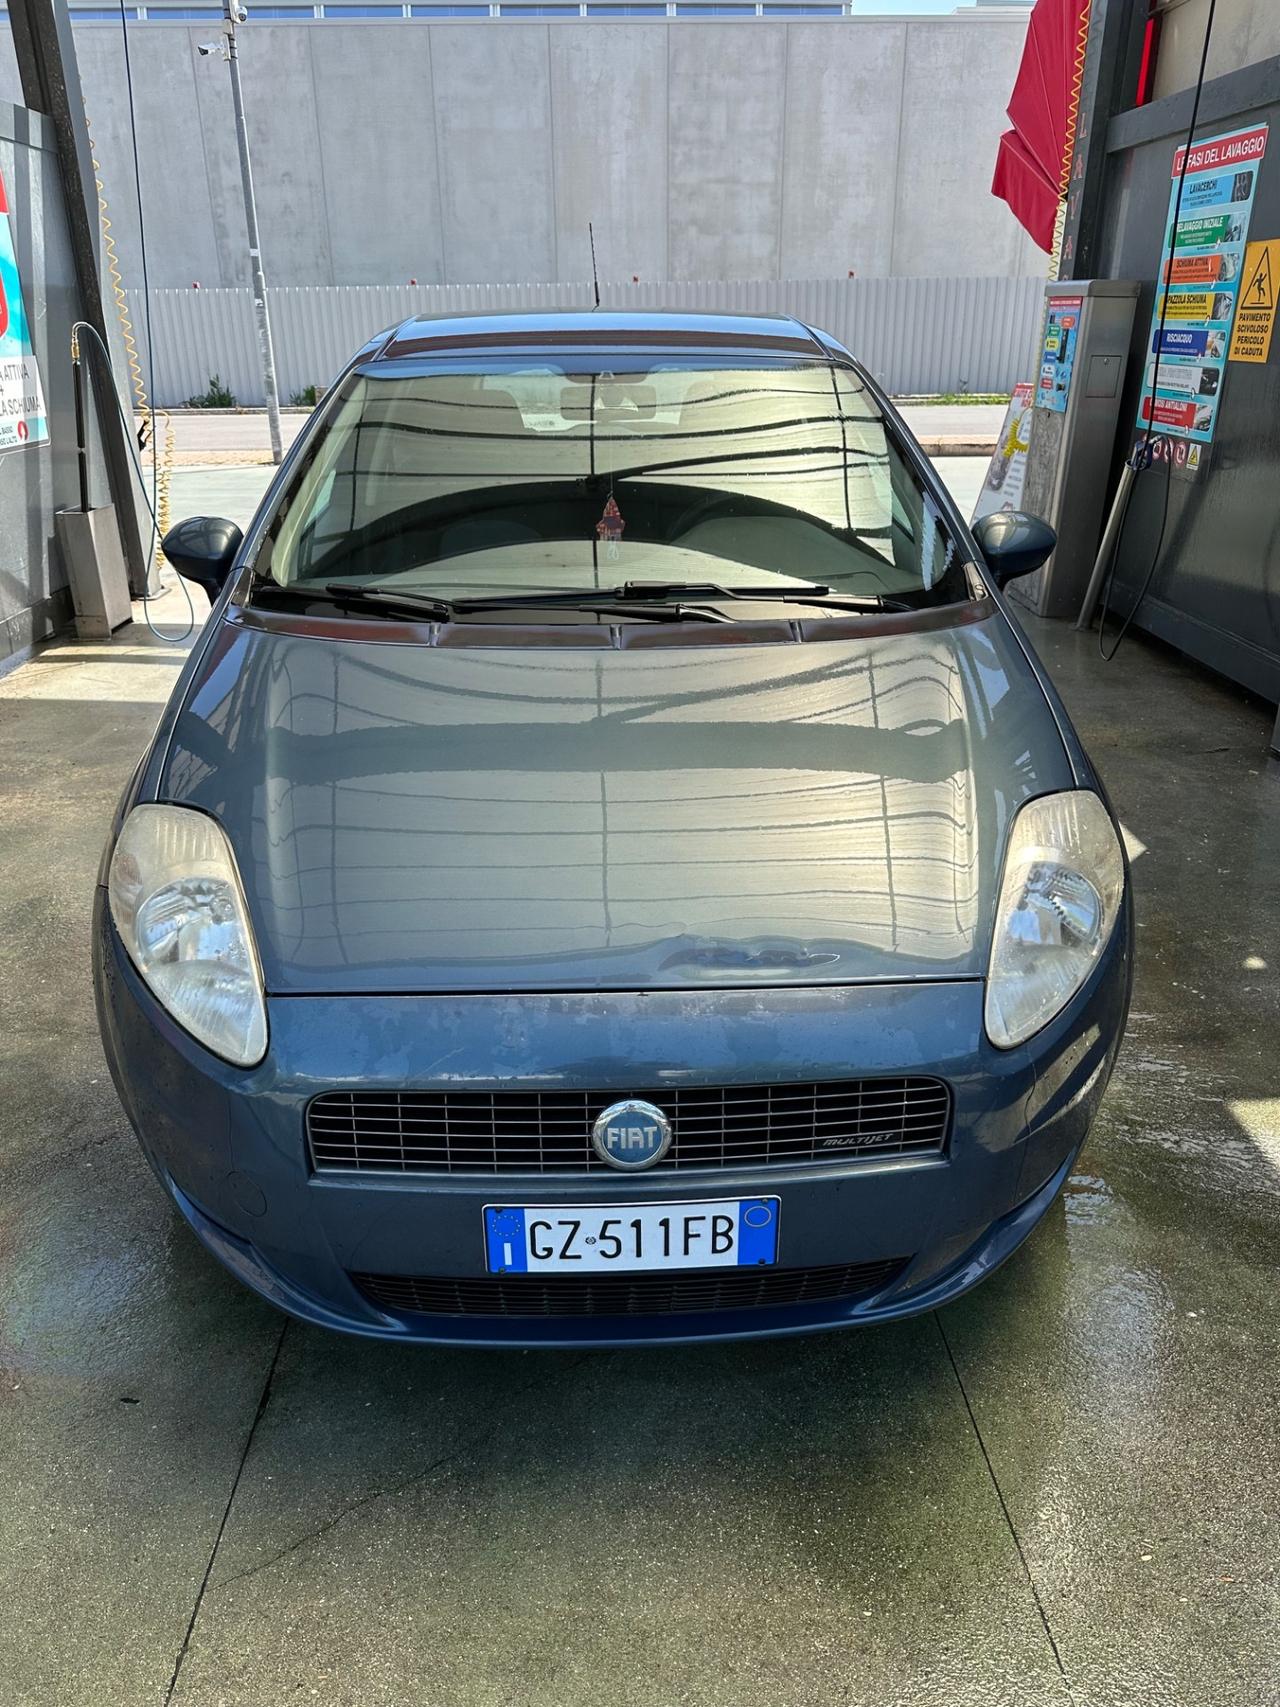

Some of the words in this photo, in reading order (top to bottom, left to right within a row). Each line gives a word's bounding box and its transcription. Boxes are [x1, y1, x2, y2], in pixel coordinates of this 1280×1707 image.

[1186, 152, 1204, 168] FASI
[1204, 148, 1219, 165] DEL
[1221, 136, 1264, 160] LAVAGGIO
[1189, 180, 1218, 194] LAVACERCHI
[1239, 312, 1271, 322] PAVIMENTO
[1237, 324, 1269, 334] SCIVOLOSO
[1237, 335, 1265, 345] PERICOLO
[1234, 346, 1241, 355] DI
[1241, 346, 1263, 356] CADUTA
[4, 363, 30, 381] ATTIVA
[8, 395, 41, 416] SCHIUMA
[606, 1126, 658, 1150] FIAT
[823, 1133, 894, 1147] MULTIJET
[529, 1219, 582, 1260] GZ
[599, 1215, 734, 1259] 511FB
